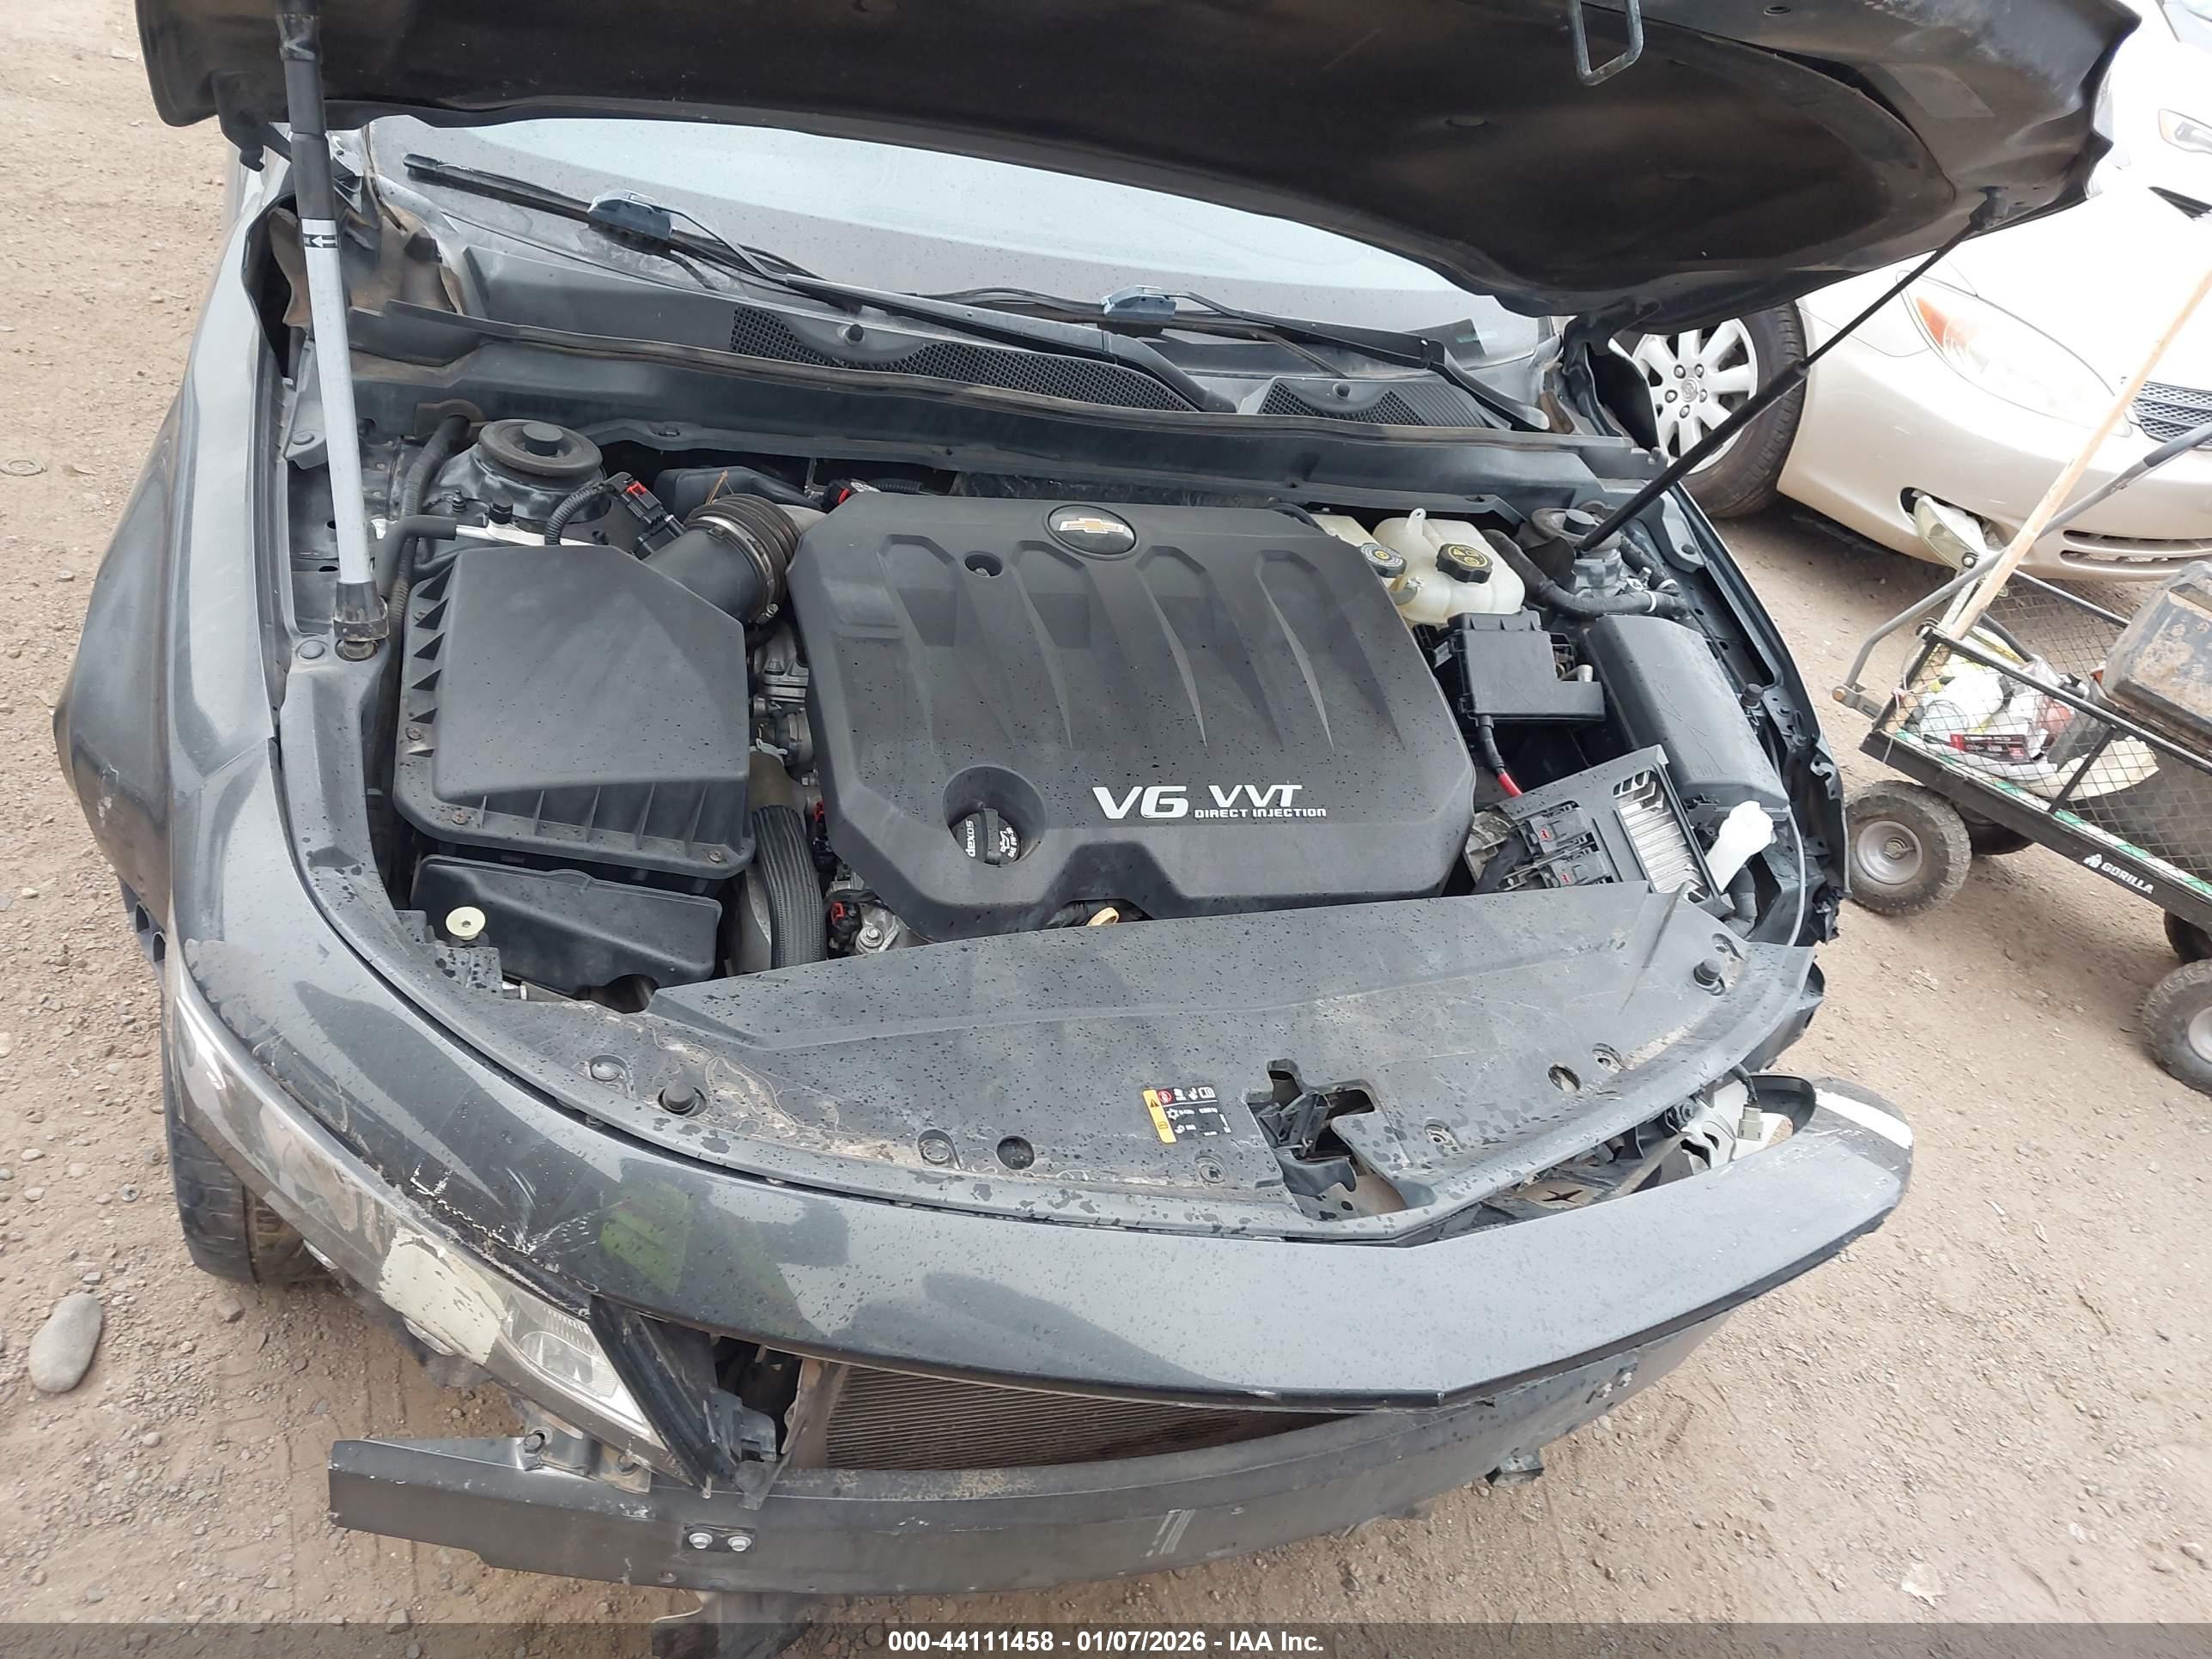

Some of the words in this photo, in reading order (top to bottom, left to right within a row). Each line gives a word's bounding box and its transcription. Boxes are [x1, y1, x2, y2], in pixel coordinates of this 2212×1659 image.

[1092, 786, 1189, 819] V6
[1208, 785, 1303, 808] VVT
[1194, 809, 1249, 818] DIRECT
[1253, 808, 1327, 818] INJECTION
[965, 820, 976, 858] dexos
[2100, 862, 2154, 895] GORILLA
